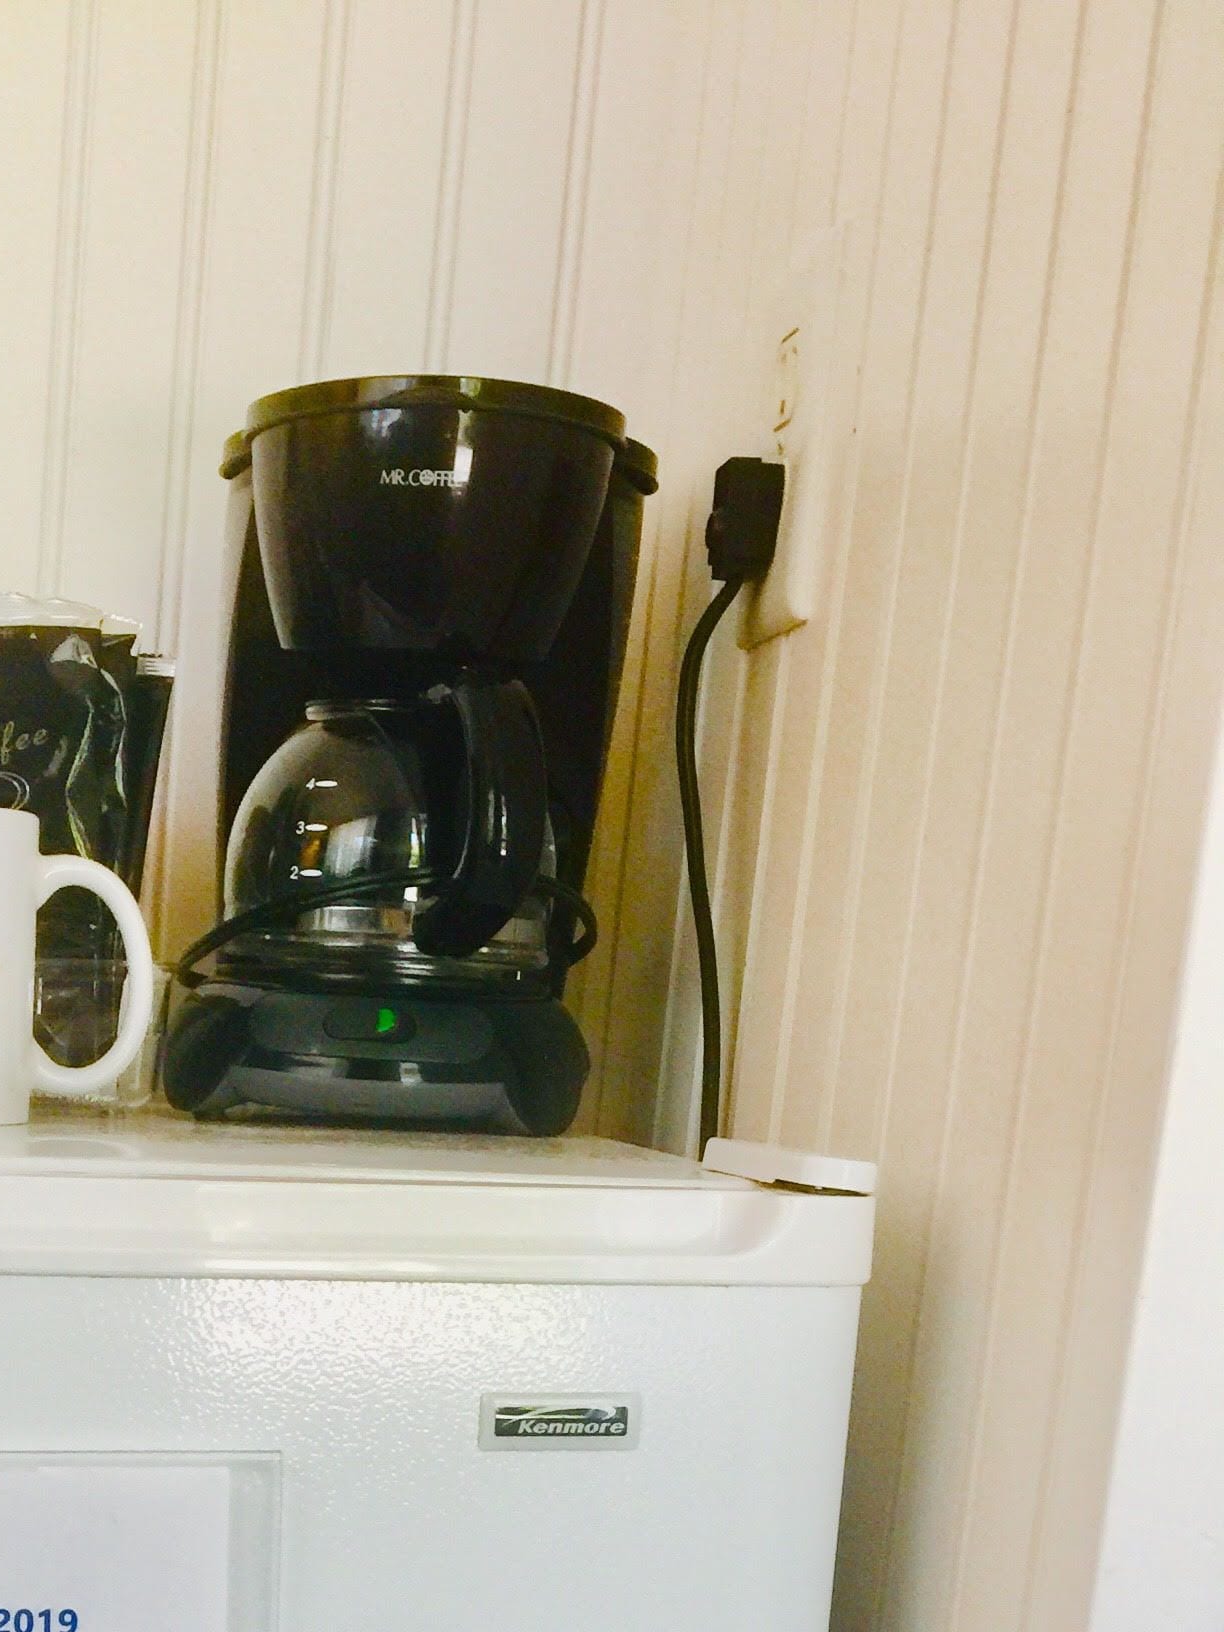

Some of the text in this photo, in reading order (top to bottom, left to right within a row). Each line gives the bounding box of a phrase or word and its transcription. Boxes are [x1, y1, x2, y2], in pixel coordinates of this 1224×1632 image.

[305, 777, 316, 791] 4
[295, 820, 306, 836] 3
[289, 865, 300, 881] 2
[518, 1420, 625, 1435] Kenmore
